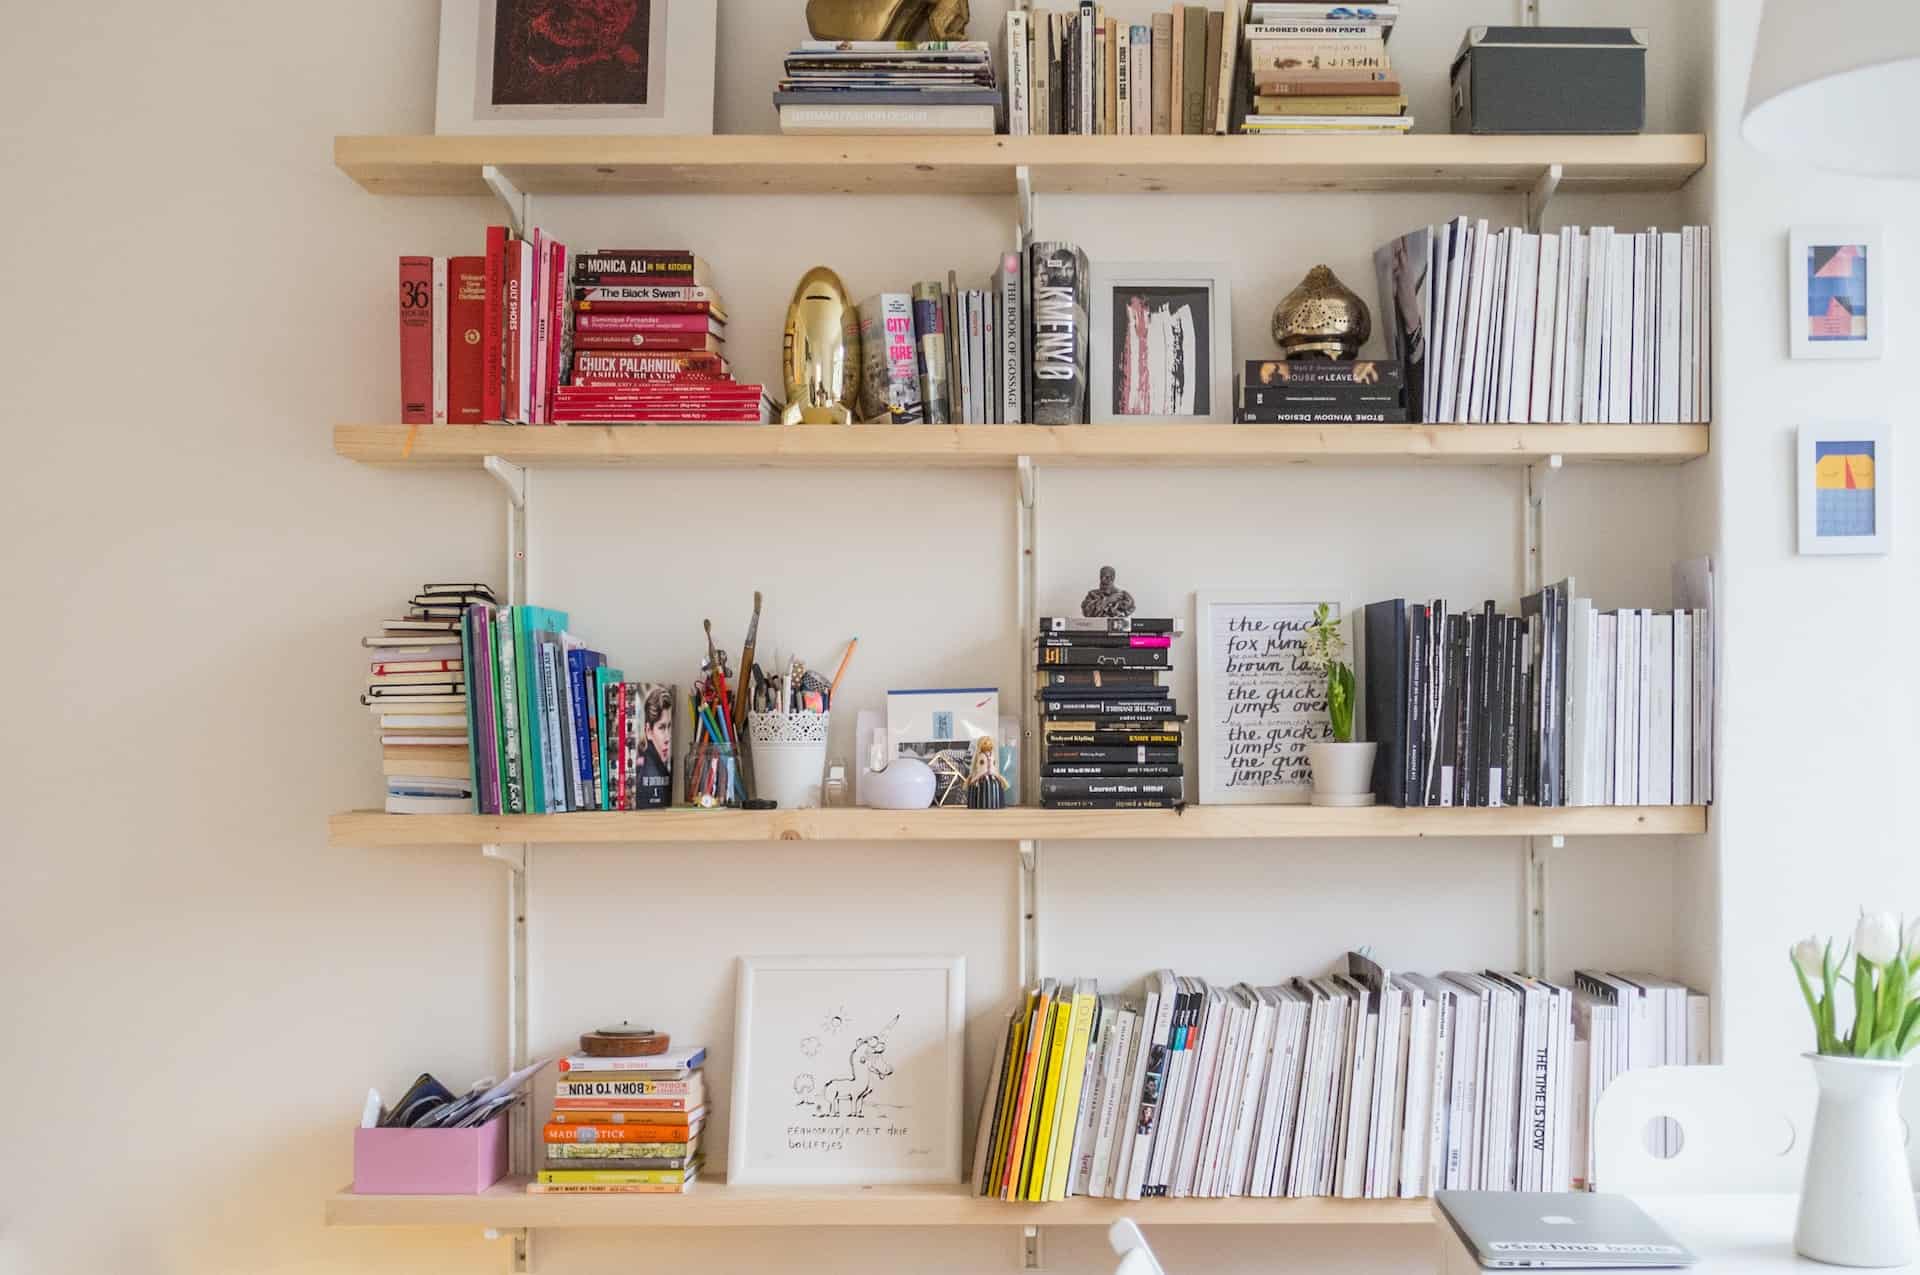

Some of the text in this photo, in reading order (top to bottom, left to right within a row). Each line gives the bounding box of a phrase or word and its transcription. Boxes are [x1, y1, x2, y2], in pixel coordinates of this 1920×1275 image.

[587, 259, 627, 273] MONICA
[630, 259, 647, 273] ALI
[655, 263, 666, 271] THE
[401, 280, 429, 309] 36
[600, 288, 681, 298] The Black Swan
[509, 279, 518, 331] CULT SHOES
[886, 317, 911, 333] CITY
[889, 346, 913, 360] FIRE
[1007, 281, 1017, 409] THE BOOK OF GOSSAGE
[579, 357, 681, 374] CHUCK PALAHNIUK
[1284, 373, 1316, 382] HOUSE
[1325, 373, 1359, 382] LEAVES
[1277, 413, 1385, 422] STORE WINDOW DESIGN
[1229, 616, 1269, 632] the
[1226, 636, 1258, 654] fox
[1228, 684, 1321, 709] the quick
[1222, 702, 1280, 724] jumps
[1228, 727, 1261, 741] the
[1266, 725, 1317, 749] quick
[1224, 743, 1282, 760] jumps
[1231, 756, 1312, 777] the quic
[1226, 769, 1313, 786] jumps ove
[1088, 785, 1117, 793] Laurent
[1118, 785, 1138, 793] Binet
[569, 1082, 644, 1095] BORN TO RUN
[1533, 1047, 1548, 1151] THE TIME IS NOW
